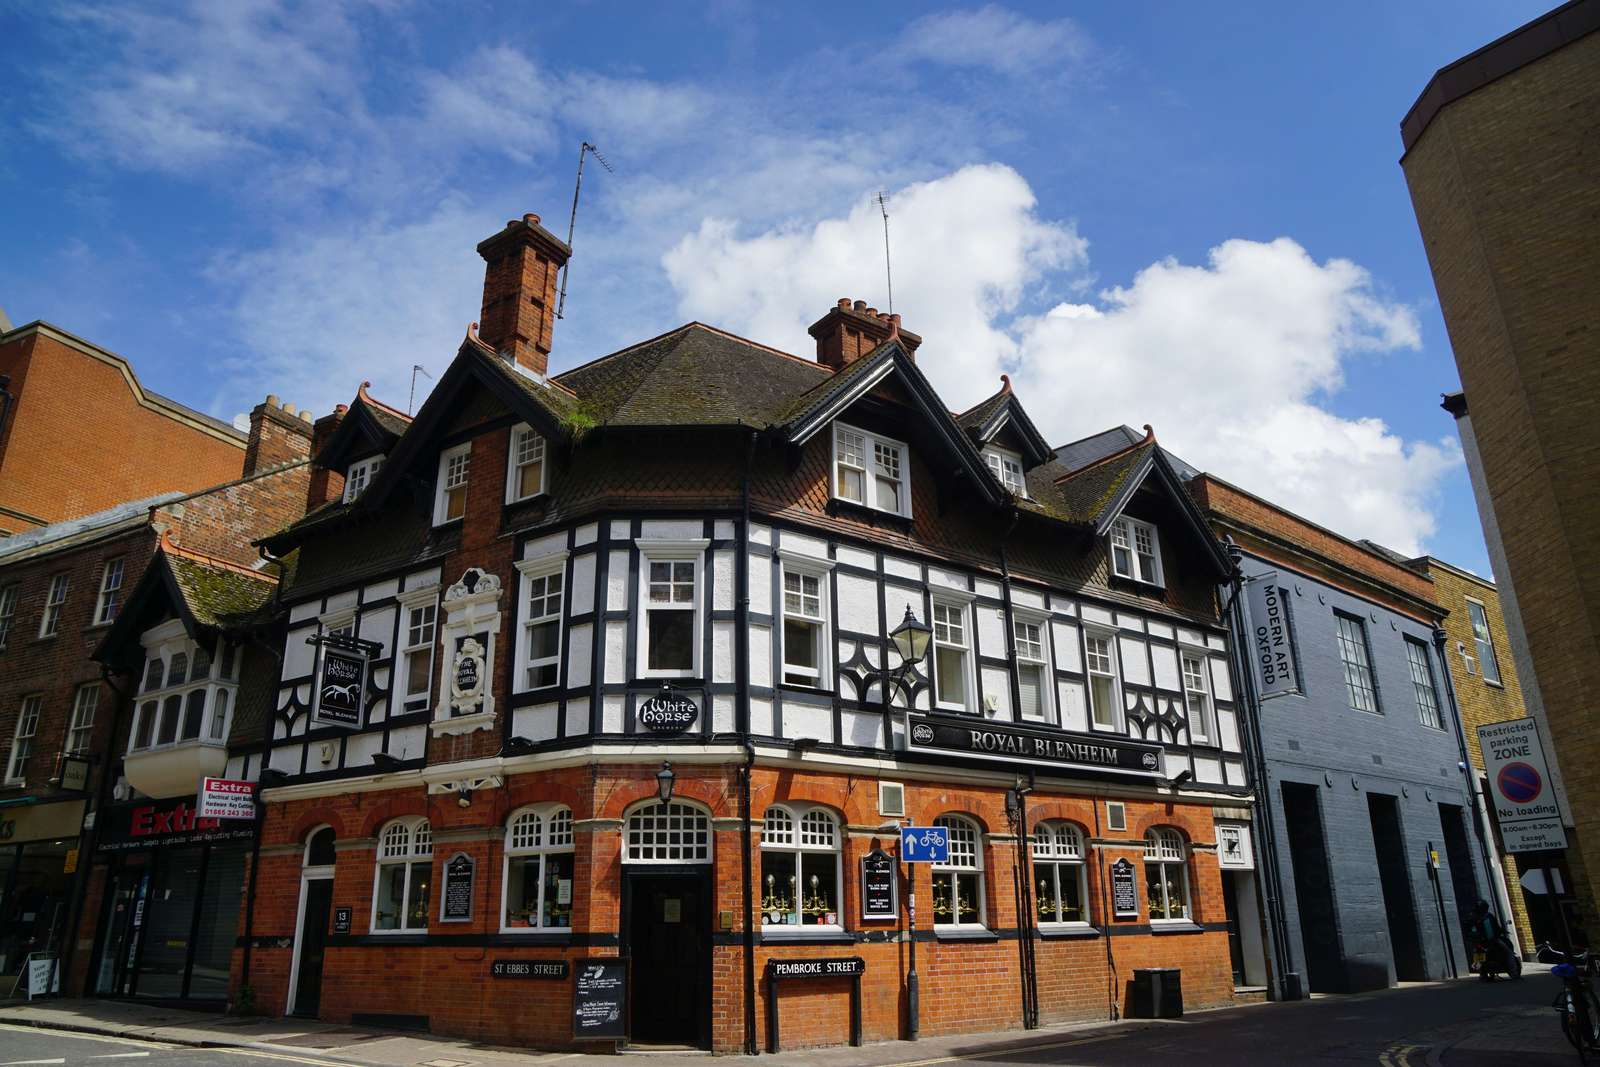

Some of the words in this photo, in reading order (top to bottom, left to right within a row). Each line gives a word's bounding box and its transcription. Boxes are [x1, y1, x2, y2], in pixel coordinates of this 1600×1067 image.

[1264, 585, 1284, 647] MODERN
[1275, 652, 1290, 680] ART
[1257, 626, 1275, 685] OXFORD
[650, 698, 696, 712] White
[642, 705, 692, 723] horse
[1479, 721, 1534, 739] Restricted
[969, 730, 1029, 754] ROYAL
[1033, 738, 1119, 764] BLENHEIM
[1490, 735, 1529, 750] parking
[1493, 745, 1531, 760] ZONE
[210, 781, 252, 793] Extra
[1498, 808, 1513, 818] No
[1516, 805, 1556, 817] loading
[339, 912, 346, 921] 13
[494, 963, 504, 974] ST
[507, 963, 529, 974] EBBES
[534, 964, 564, 975] STREET
[776, 962, 822, 974] PEMBROKE
[826, 961, 857, 972] STREET
